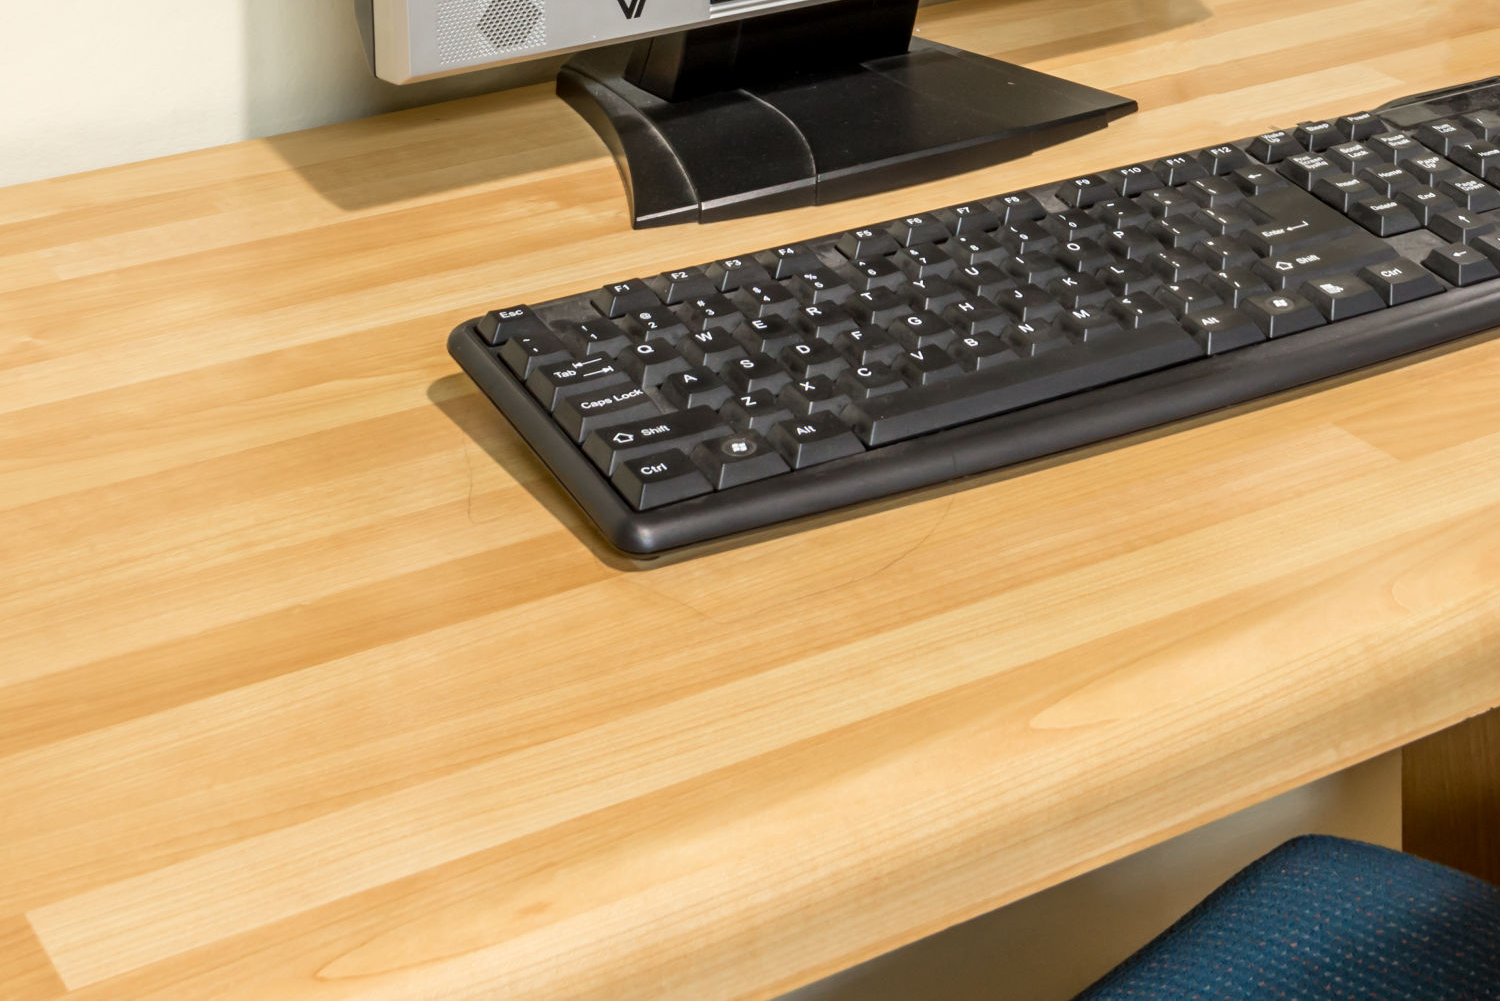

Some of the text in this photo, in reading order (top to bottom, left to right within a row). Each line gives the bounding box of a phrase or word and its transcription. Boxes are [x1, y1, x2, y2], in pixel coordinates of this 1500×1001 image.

[1210, 146, 1232, 156] F12
[1166, 157, 1186, 166] F11
[1120, 166, 1142, 176] F10
[1378, 169, 1403, 178] Home
[1075, 178, 1091, 187] F9
[1004, 196, 1020, 204] F8
[1417, 192, 1437, 200] End
[956, 206, 970, 214] F7
[1370, 202, 1398, 211] Delete
[906, 217, 923, 225] F6
[856, 229, 873, 238] F5
[1112, 230, 1125, 239] P
[1261, 228, 1285, 237] Enter
[778, 247, 795, 256] F4
[1066, 242, 1081, 251] O
[725, 259, 742, 268] F3
[1015, 256, 1025, 264] I
[1295, 254, 1321, 264] Shift
[964, 266, 980, 276] U
[1110, 266, 1125, 274] L
[1380, 268, 1403, 278] Ctrl
[671, 271, 689, 280] F2
[912, 279, 926, 289] Y
[1062, 276, 1078, 287] K
[614, 284, 630, 293] F1
[860, 291, 873, 301] T
[1014, 289, 1024, 299] J
[705, 308, 715, 316] 3
[805, 306, 823, 316] R
[958, 302, 975, 312] H
[499, 309, 524, 319] Esc
[1071, 309, 1091, 319] M
[752, 320, 768, 329] E
[907, 316, 923, 326] G
[1201, 316, 1221, 326] Alt
[1017, 323, 1035, 333] N
[695, 331, 713, 342] W
[851, 330, 863, 340] F
[963, 338, 979, 347] B
[637, 345, 655, 354] Q
[795, 345, 811, 354] D
[910, 350, 924, 361] V
[740, 359, 755, 368] S
[553, 369, 577, 379] Tab
[857, 367, 872, 377] C
[683, 374, 698, 383] A
[799, 381, 816, 392] X
[580, 388, 645, 410] Caps Lock
[741, 396, 757, 407] Z
[640, 424, 671, 436] Shift
[796, 425, 817, 435] Alt
[640, 462, 668, 476] Ctrl
